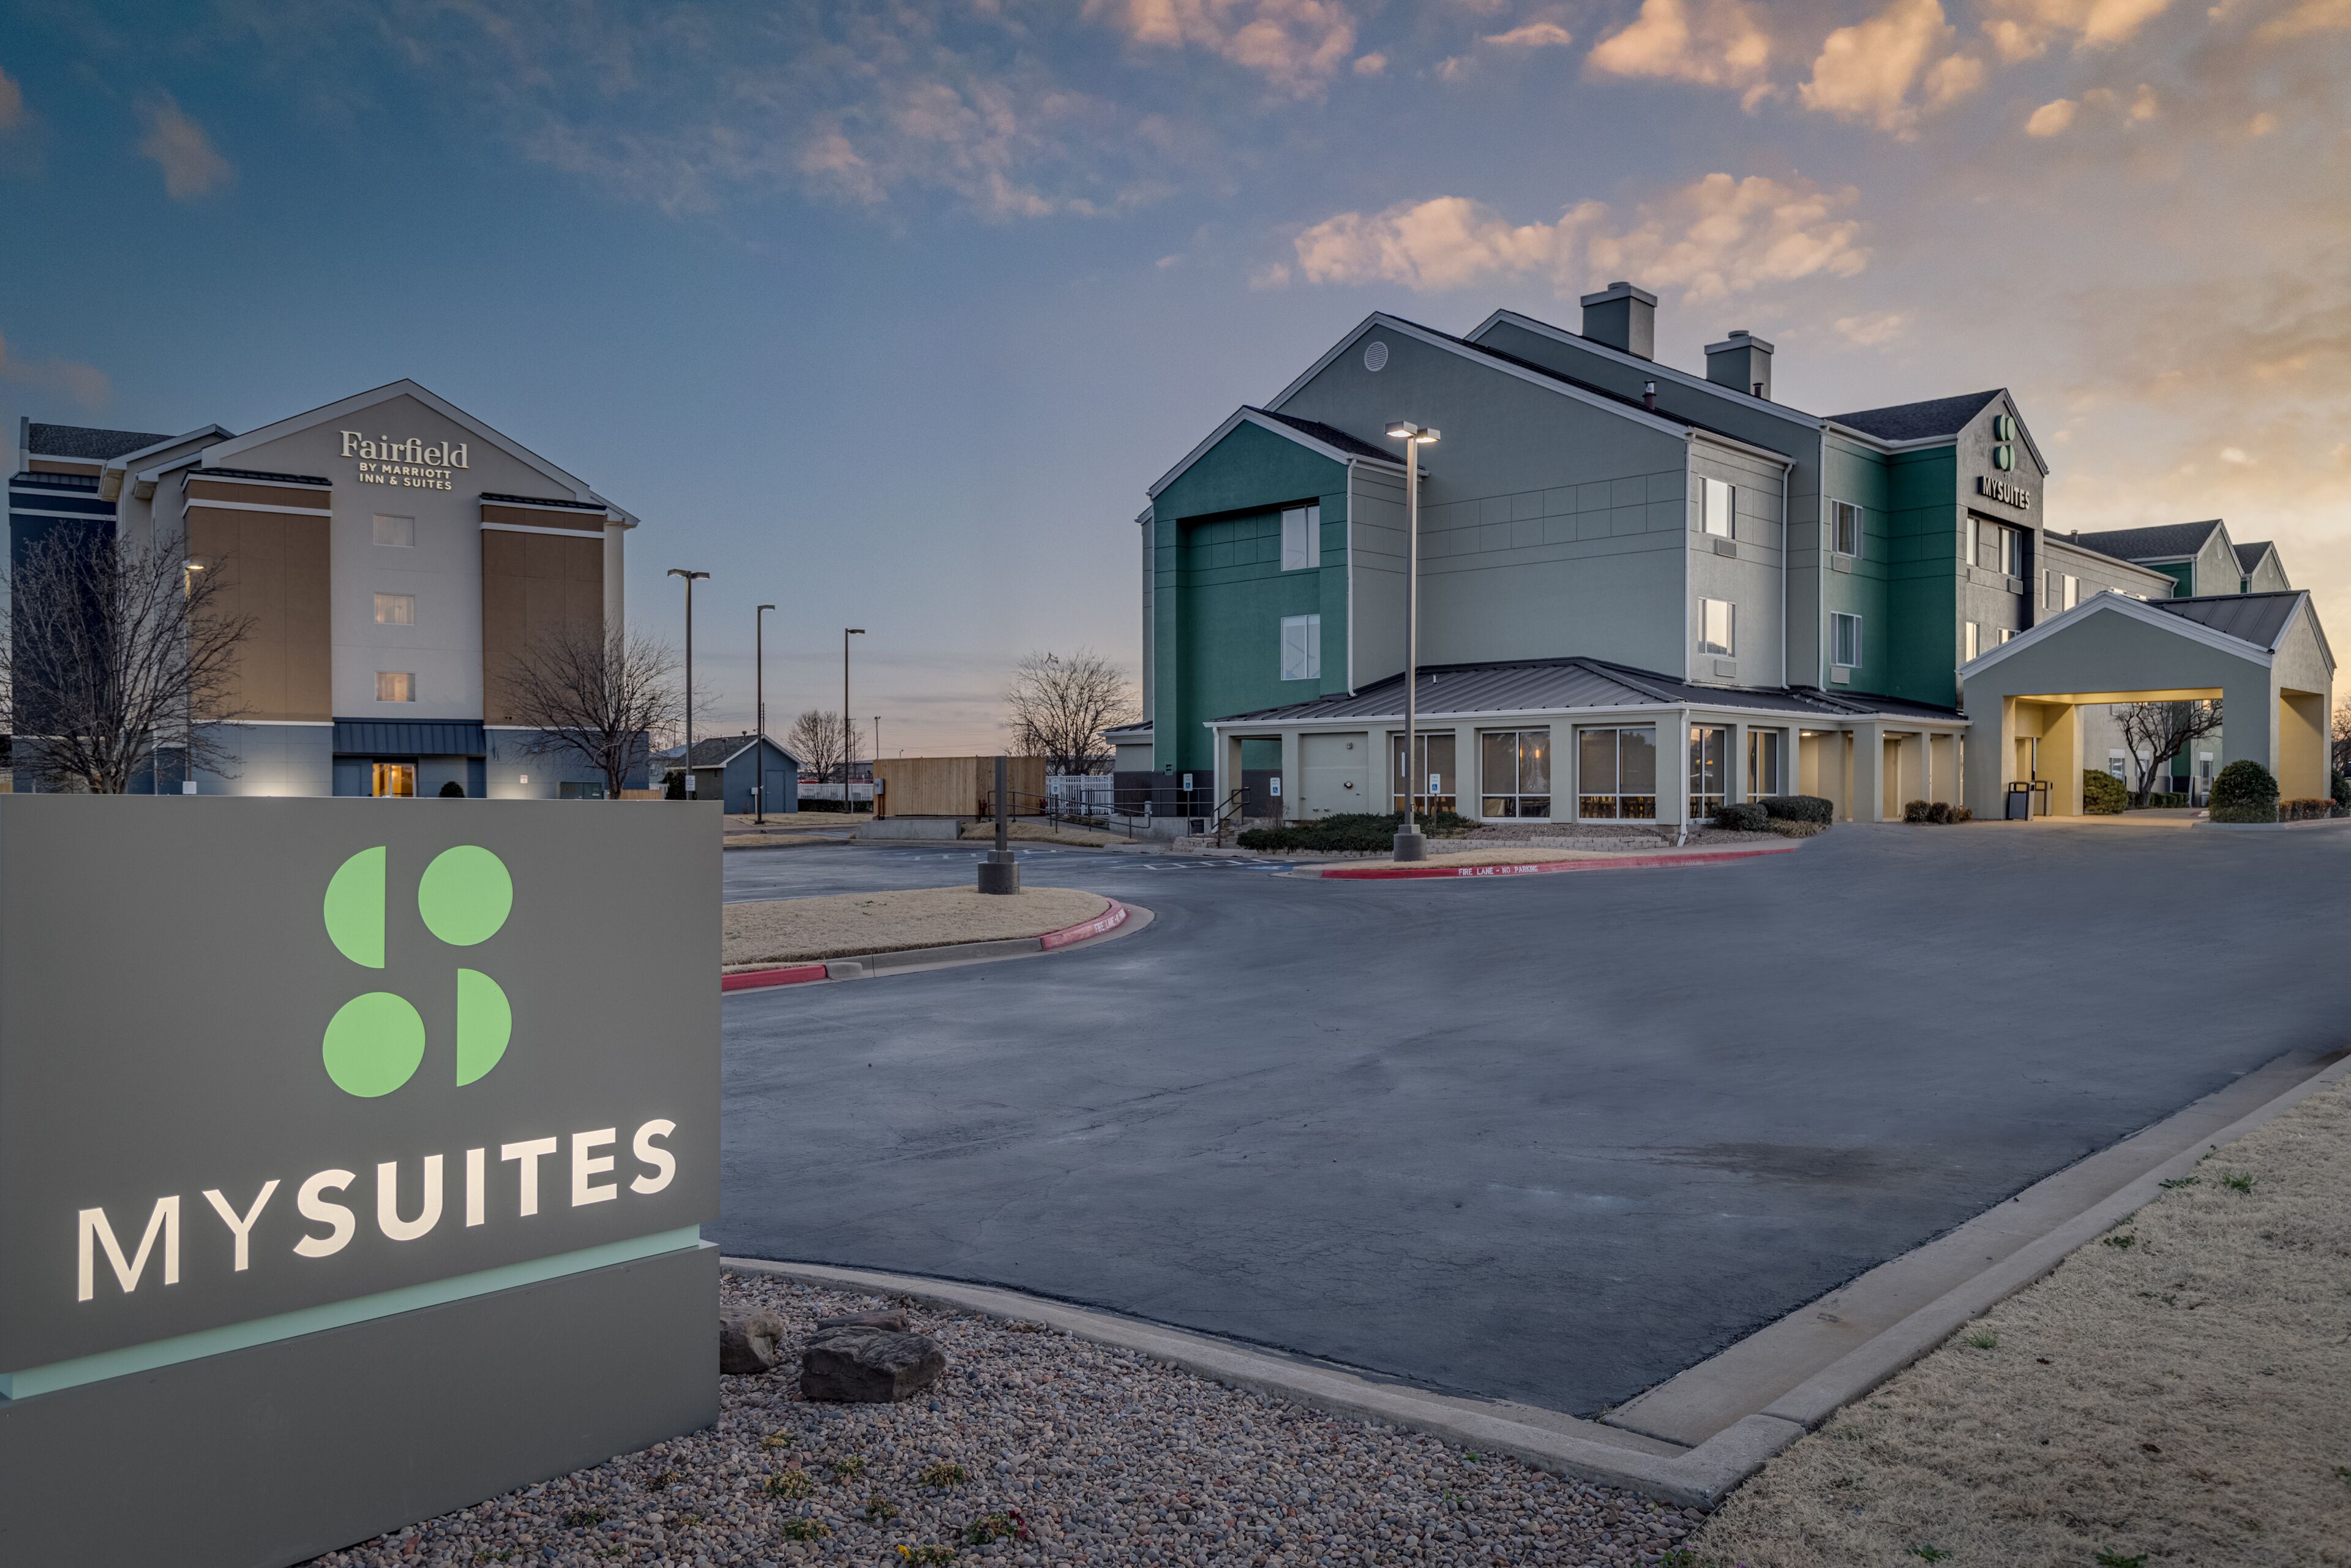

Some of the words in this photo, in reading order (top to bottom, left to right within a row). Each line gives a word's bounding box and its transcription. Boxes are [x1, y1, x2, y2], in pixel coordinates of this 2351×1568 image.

[340, 430, 470, 469] Fairfield
[359, 462, 377, 472] BY
[382, 463, 451, 479] MARRIOTT
[359, 473, 384, 484] INN
[389, 476, 399, 486] &
[403, 477, 452, 490] SUITES
[1982, 475, 2030, 510] MYSUITES
[1477, 867, 1494, 876] LANE
[1514, 865, 1539, 874] PARKING
[78, 1119, 677, 1302] MYSUITES
